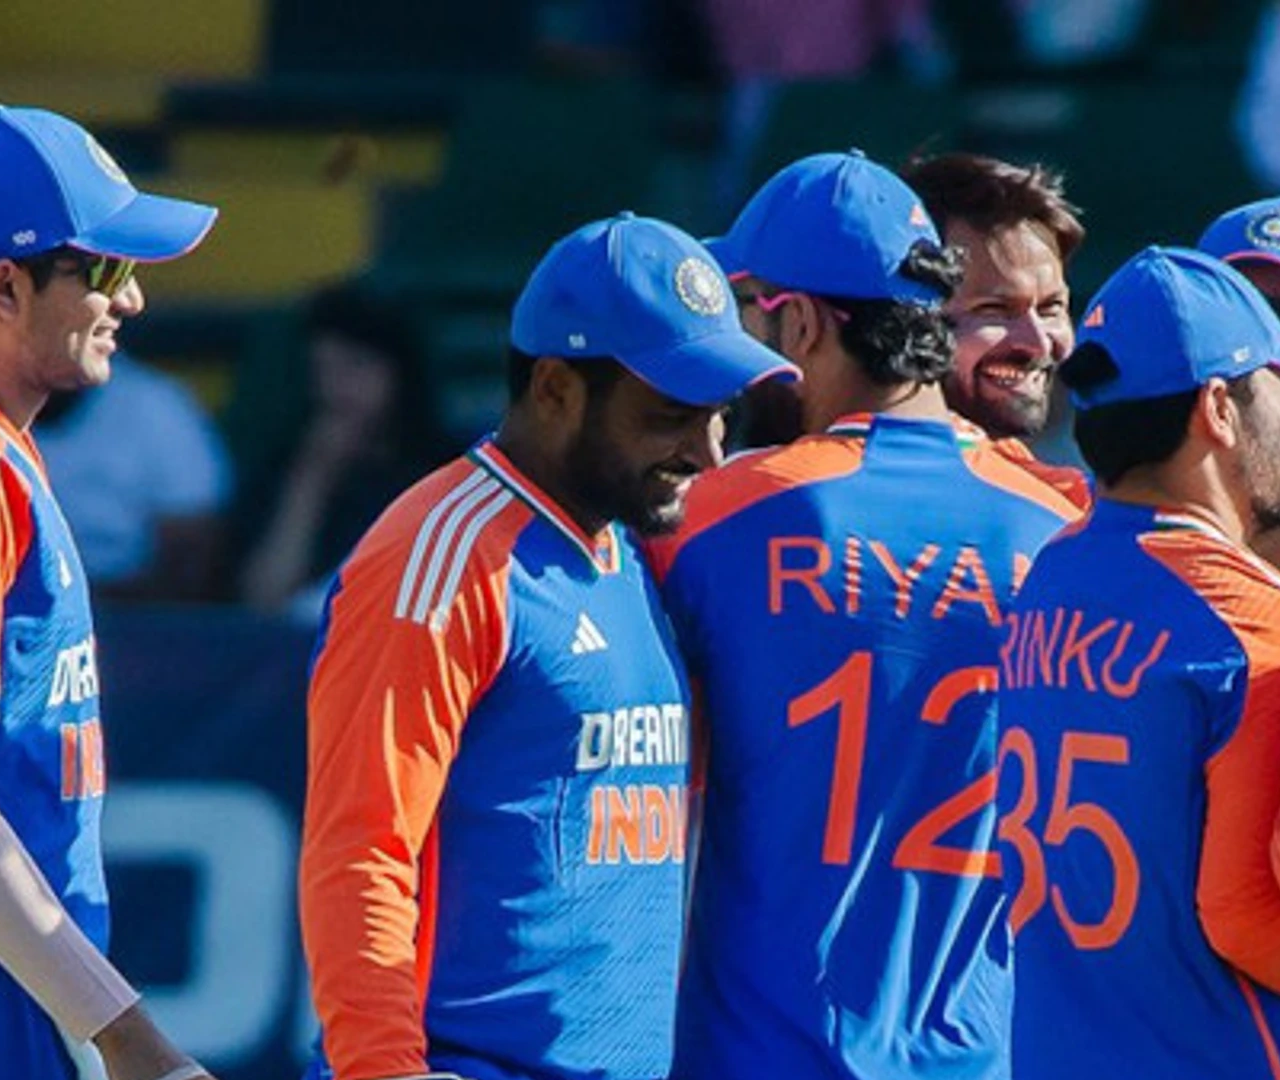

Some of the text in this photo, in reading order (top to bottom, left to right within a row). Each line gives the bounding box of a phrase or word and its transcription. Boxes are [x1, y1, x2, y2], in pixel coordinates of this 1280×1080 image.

[585, 784, 689, 865] INDI
[786, 650, 1004, 878] 12
[996, 725, 1141, 950] 35
